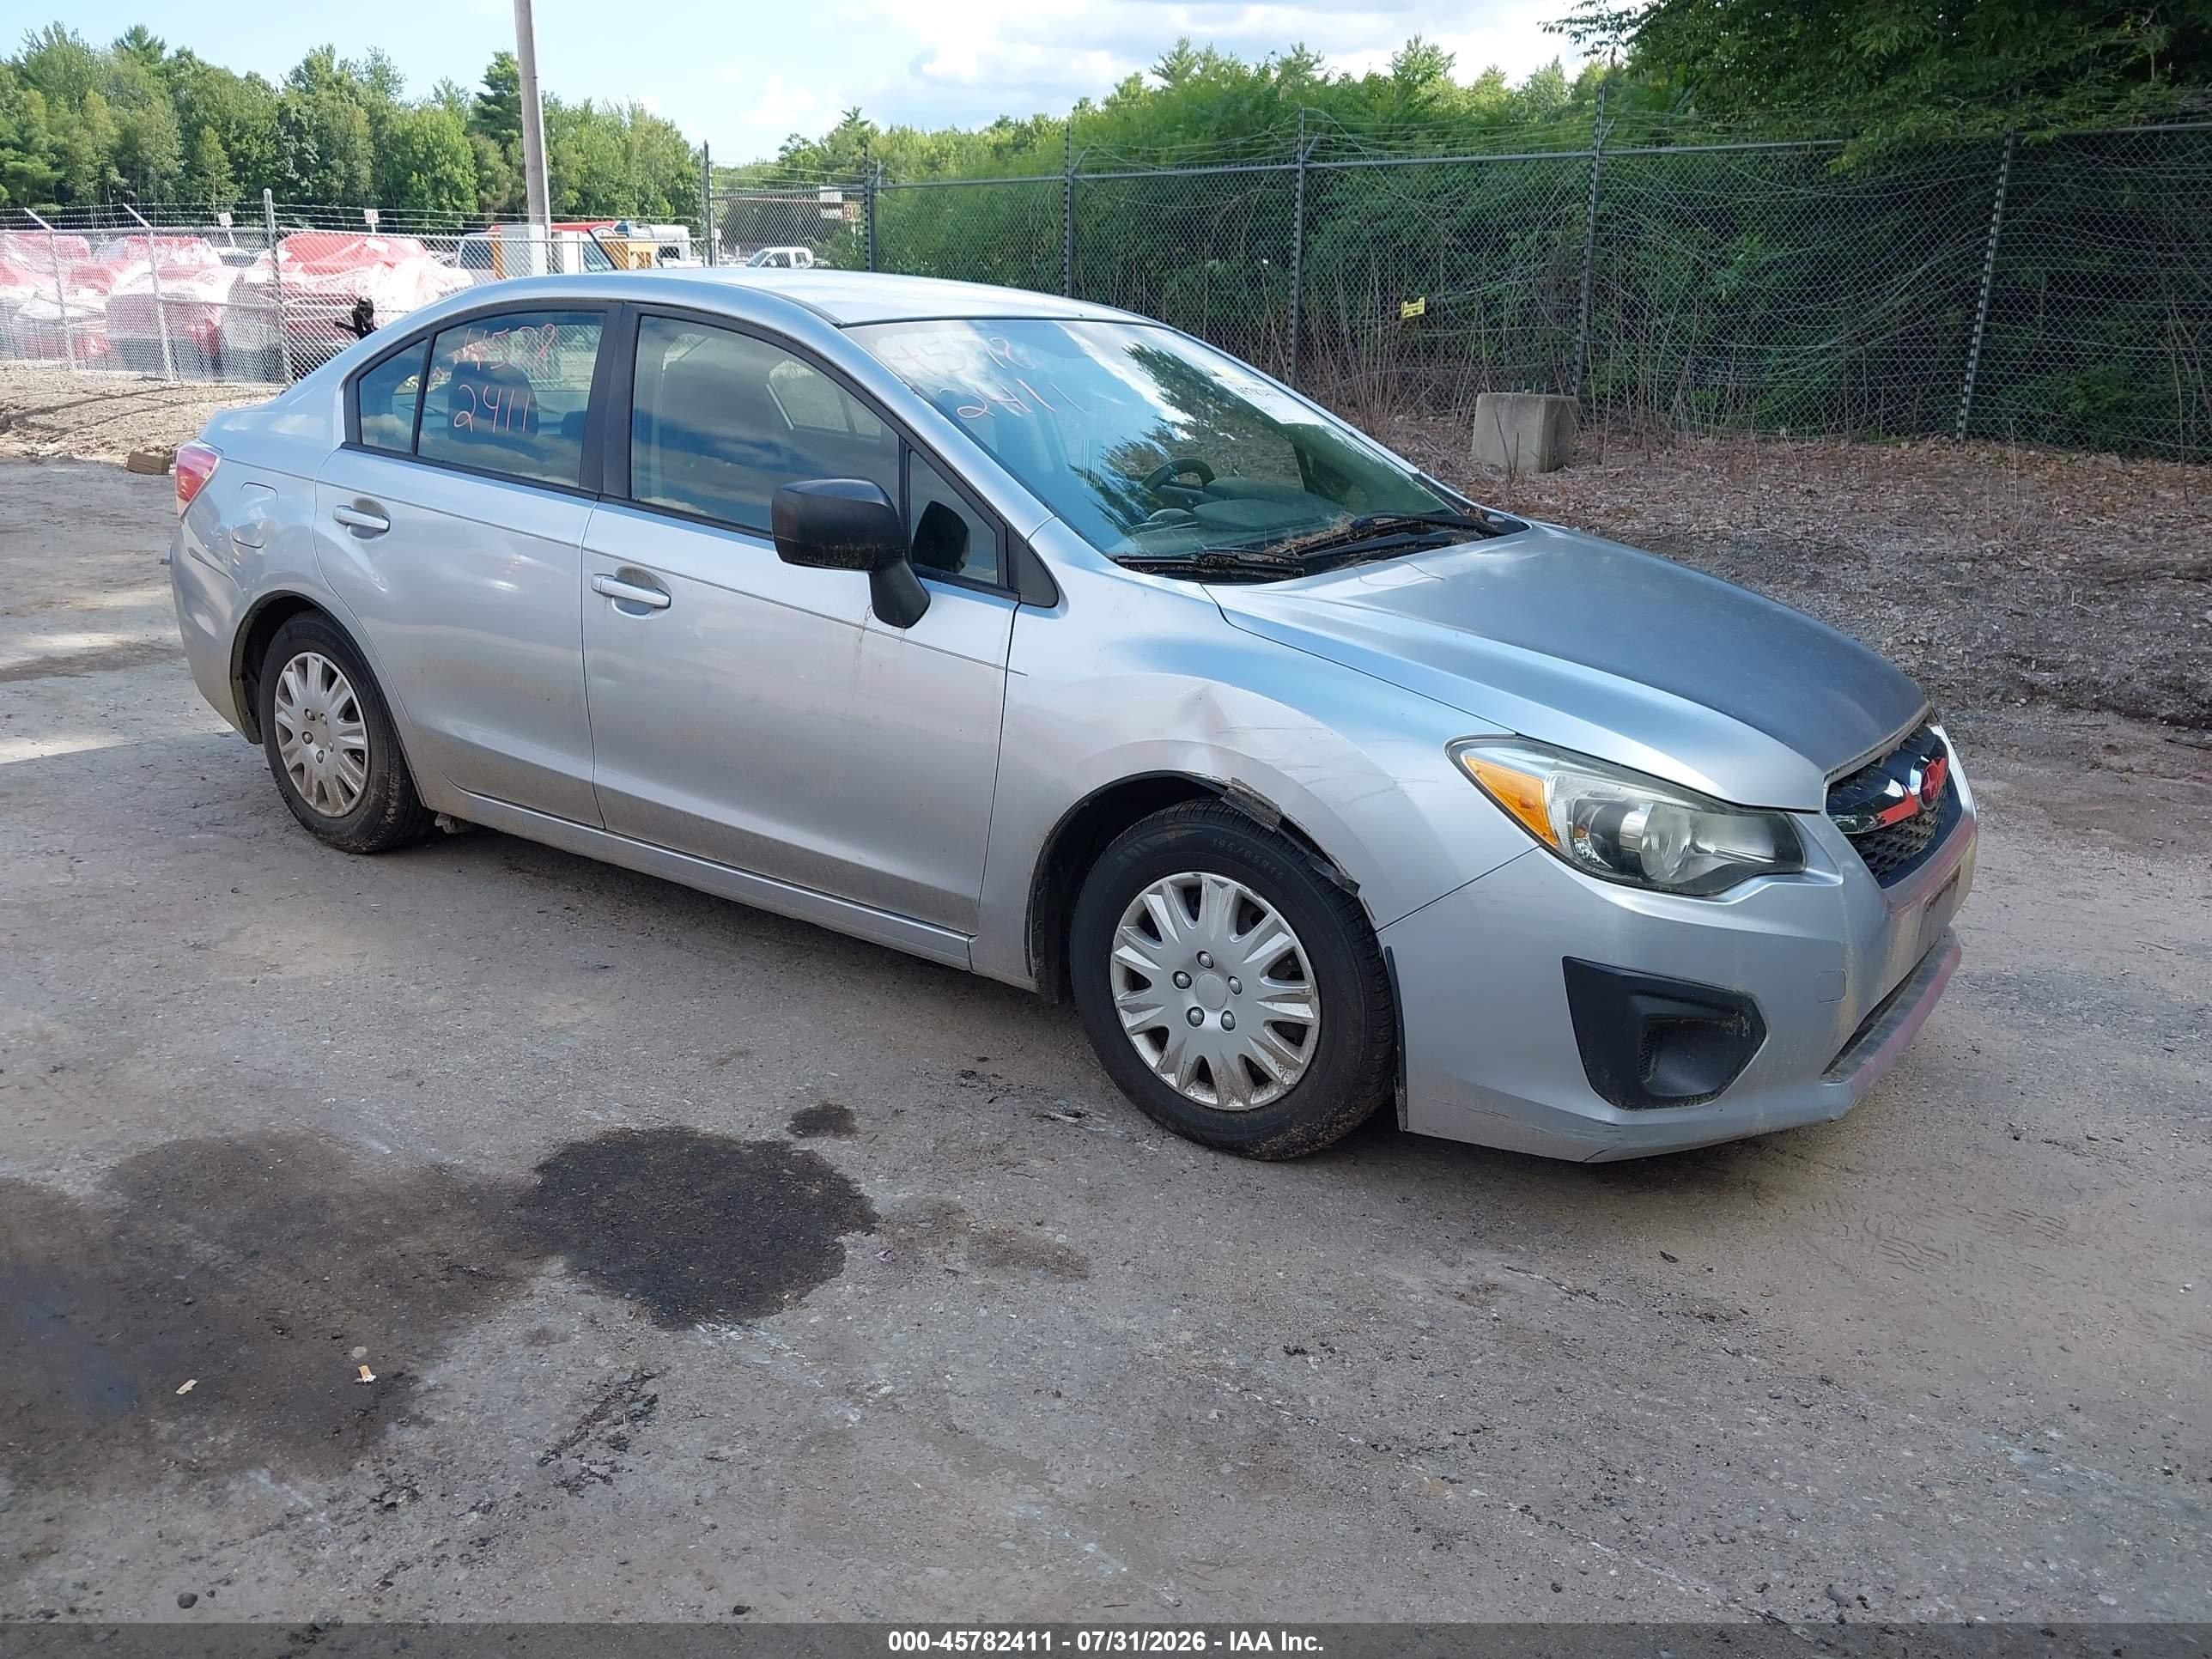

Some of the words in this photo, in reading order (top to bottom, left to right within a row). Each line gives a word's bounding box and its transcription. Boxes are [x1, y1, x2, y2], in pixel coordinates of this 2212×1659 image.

[366, 211, 378, 221] BC
[453, 383, 531, 434] 2411
[939, 378, 1087, 419] 2411
